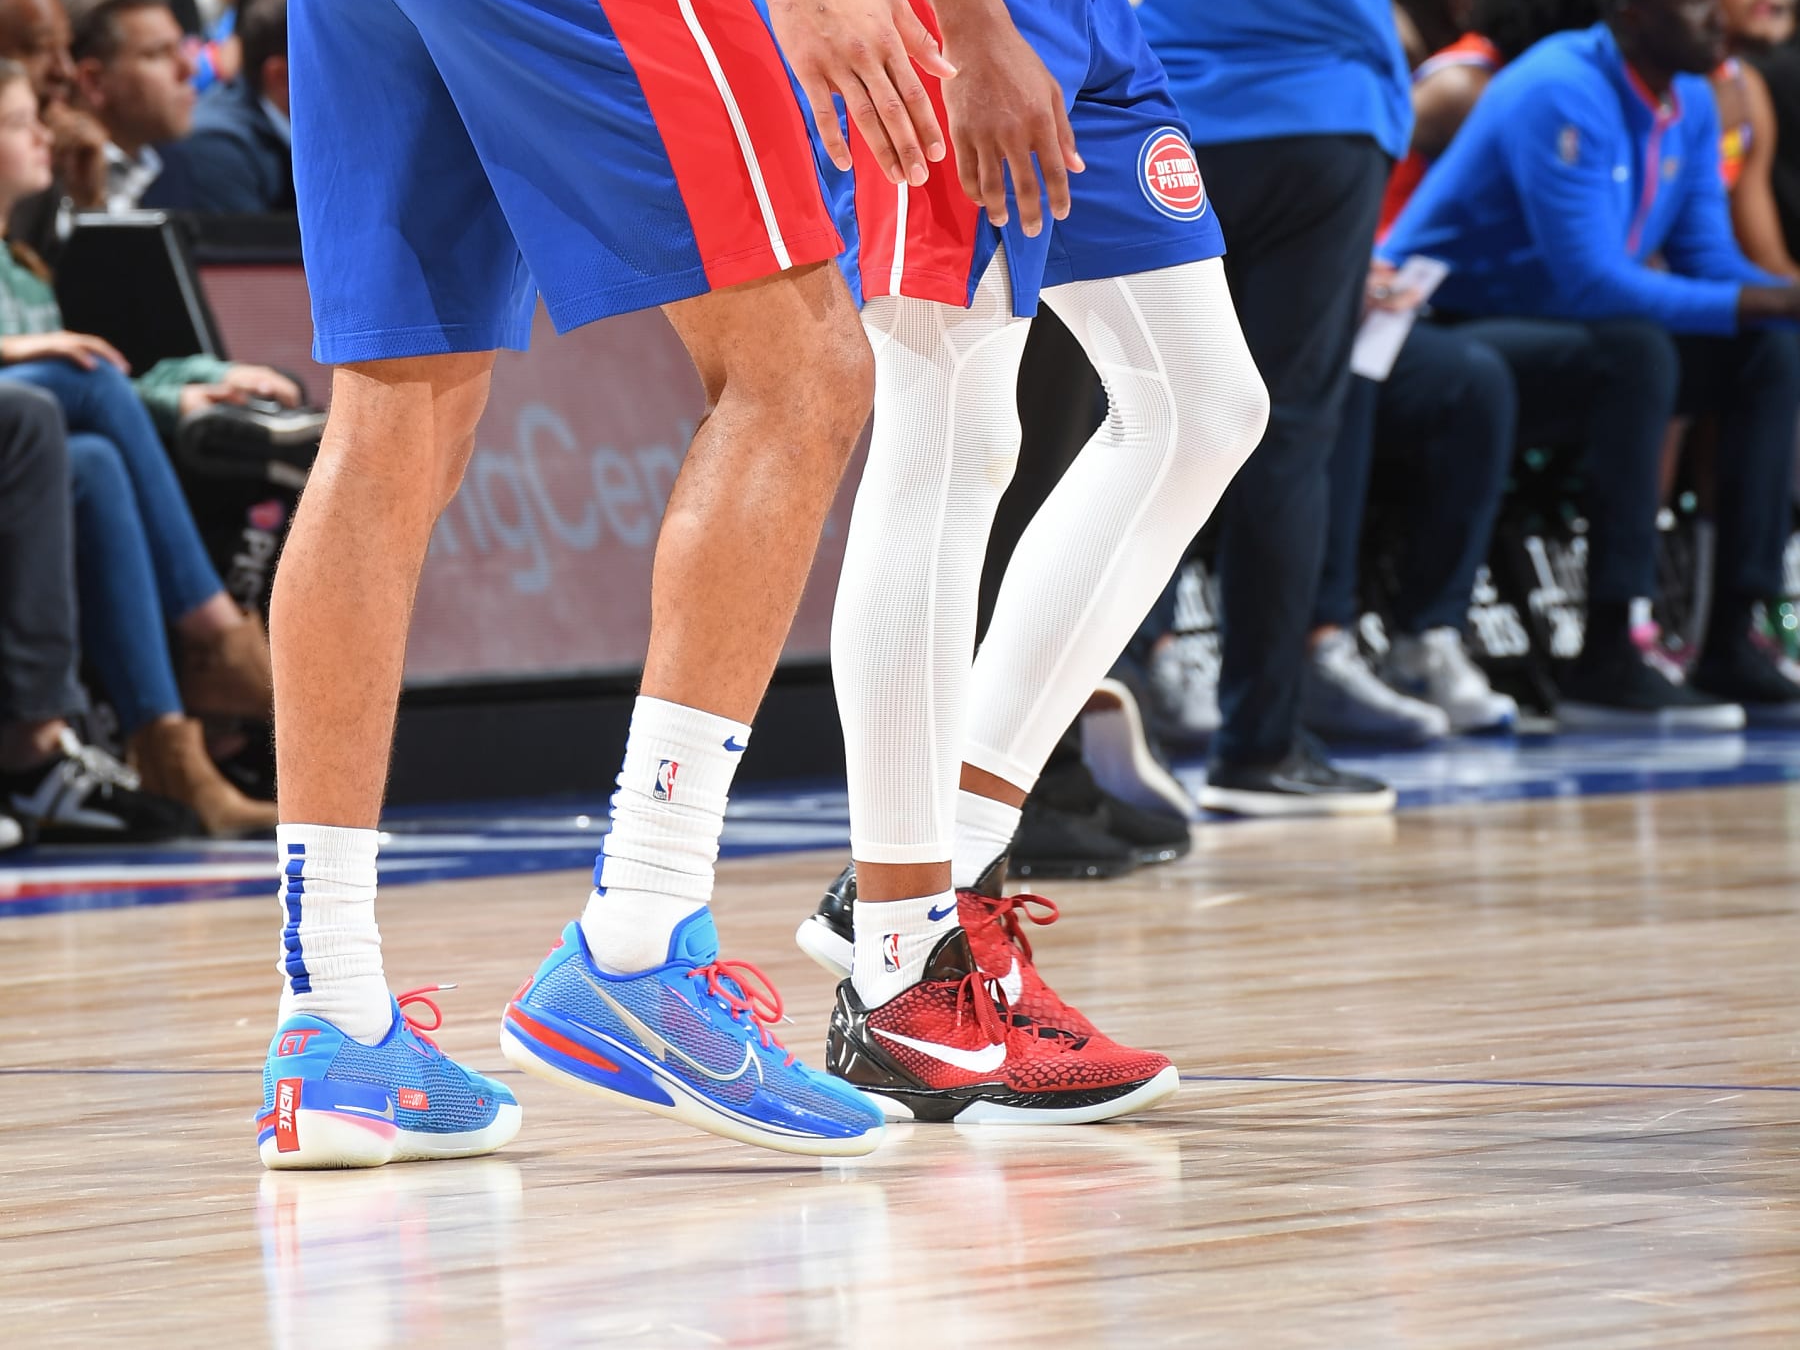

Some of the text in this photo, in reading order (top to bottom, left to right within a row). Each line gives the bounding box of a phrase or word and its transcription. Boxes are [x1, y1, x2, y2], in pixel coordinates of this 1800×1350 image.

[1155, 158, 1195, 175] DETROIT
[1158, 172, 1199, 190] PISTONS
[277, 1029, 321, 1057] GT
